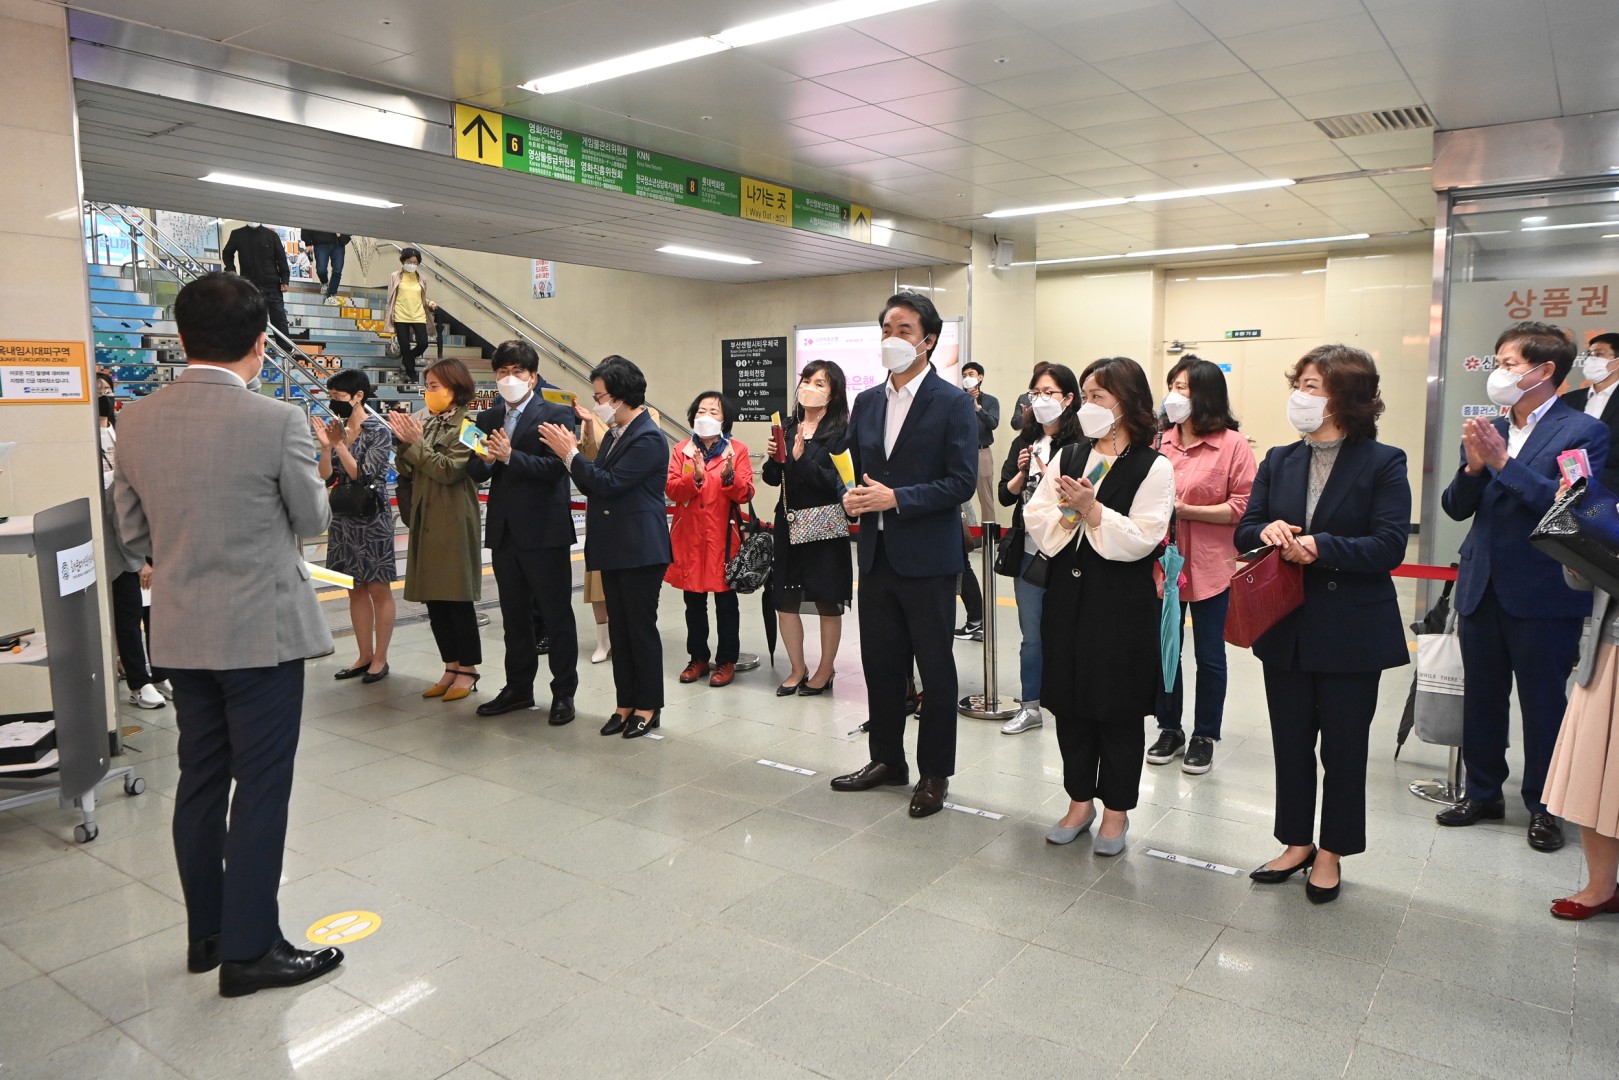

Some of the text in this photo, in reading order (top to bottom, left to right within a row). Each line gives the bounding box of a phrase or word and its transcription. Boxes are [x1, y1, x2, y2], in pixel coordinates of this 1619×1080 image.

[529, 123, 562, 140] 영화의전당
[512, 138, 518, 152] 6
[582, 137, 627, 156] 게임물관리위원회
[528, 149, 575, 169] 영상물등급위원회
[637, 150, 650, 161] KNN
[581, 162, 623, 179] 영화진흥위원회
[690, 180, 695, 192] 8
[702, 177, 725, 190] 롯데백화점
[746, 185, 786, 210] 나가는 곳
[750, 208, 761, 219] Way
[763, 210, 772, 220] Out
[843, 209, 847, 219] 2
[1504, 285, 1609, 320] 상품권
[730, 340, 778, 349] 부산센텀시티우체국
[1464, 406, 1496, 416] 홈플러스
